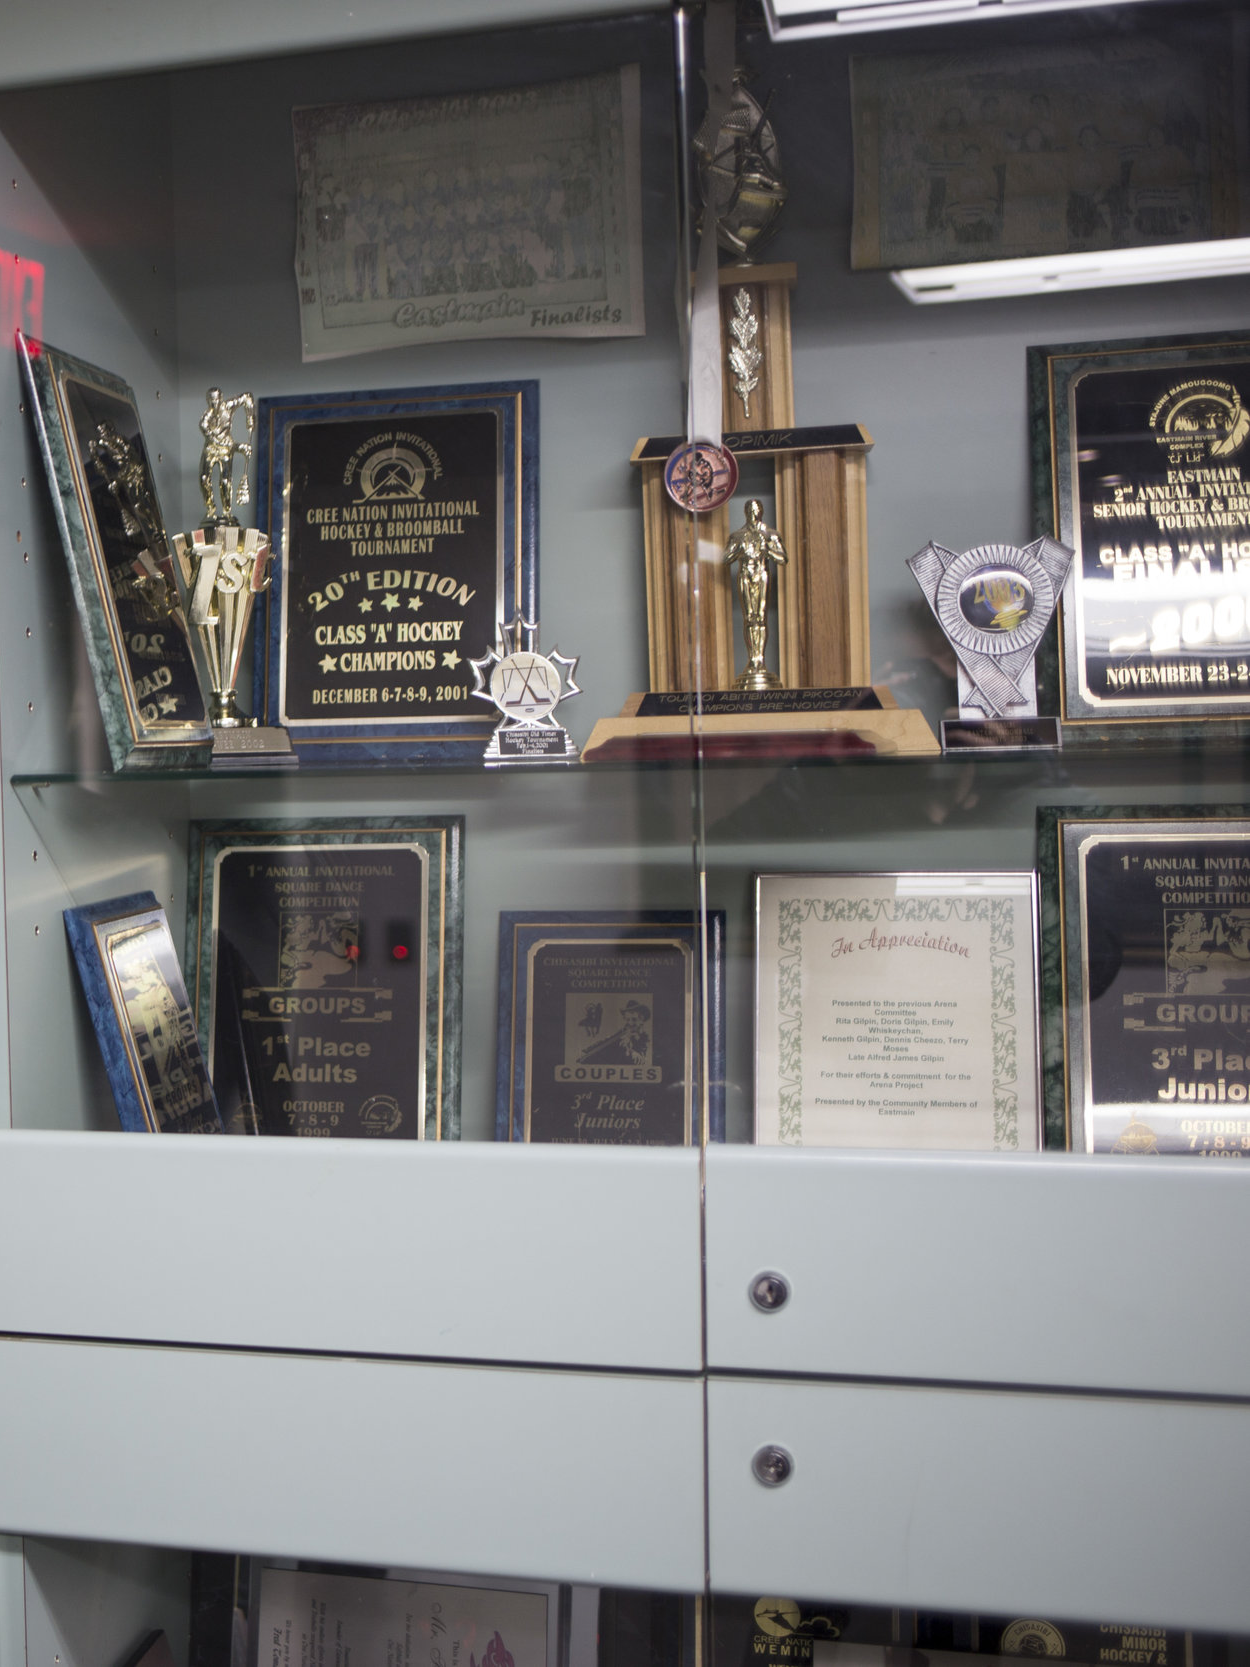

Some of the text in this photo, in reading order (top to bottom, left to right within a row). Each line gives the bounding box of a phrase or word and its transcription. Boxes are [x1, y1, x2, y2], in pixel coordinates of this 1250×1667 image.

[530, 304, 622, 327] Finalists
[724, 433, 793, 448] OPIMIK
[1156, 436, 1193, 444] EASTMAIN
[1170, 442, 1205, 451] COMPLEX
[343, 432, 443, 485] CREE NATION INVITATIONAL
[1168, 467, 1241, 484] EASTMAIN
[1114, 486, 1133, 502] 2nd
[1136, 485, 1191, 501] ANNUAL
[307, 500, 480, 524] CREE NATION INVITATIONAL
[1094, 497, 1250, 518] SENIOR HOCKEY & BR
[321, 518, 465, 541] HOCKEY & BROOMBALL
[351, 538, 435, 557] TOURNAMENT
[1100, 546, 1173, 564] CLASS
[1179, 544, 1215, 560] "A"
[308, 570, 477, 612] 20TH EDITION
[316, 620, 464, 645] CLASS "A" HOCKEY
[340, 650, 436, 672] CHAMPIONS
[1106, 666, 1203, 685] NOVEMBER
[313, 686, 468, 704] DECEMBER 6-7-8-9, 2001
[720, 690, 798, 701] ABITIBIWINNI
[802, 689, 863, 699] PIKOGAN
[679, 700, 840, 713] CHAMPIONS PRE-NOVICE
[1121, 856, 1139, 870] 1st
[1144, 858, 1200, 870] ANNUAL
[266, 866, 311, 877] ANNUAL
[315, 865, 396, 877] INVITATIONAL
[275, 881, 365, 894] SQUARE DANCE
[1155, 875, 1214, 889] SQUARE
[279, 896, 360, 908] COMPETITION
[831, 926, 971, 959] In Appreciation
[544, 957, 678, 967] CHISASIBI INVITATIONAL
[568, 968, 652, 978] SQUARE DANCE
[572, 979, 648, 989] COMPETITION
[269, 996, 367, 1015] GROUPS
[832, 1000, 871, 1008] Presented
[884, 1000, 896, 1008] the
[898, 1000, 932, 1010] previous
[934, 1000, 958, 1008] Arena
[854, 1018, 879, 1027] Gilpin,
[904, 1018, 930, 1027] Gilpin,
[932, 1018, 955, 1027] Emily
[868, 1027, 924, 1036] Whiskeychan,
[262, 1034, 372, 1057] 1st Place
[856, 1036, 882, 1045] Gilpin,
[884, 1036, 912, 1044] Dennis
[948, 1037, 969, 1046] Terry
[883, 1045, 909, 1053] Moses
[867, 1054, 891, 1062] Alfred
[893, 1054, 919, 1062] James
[920, 1055, 945, 1064] Gilpin
[1152, 1045, 1188, 1070] 3rd
[273, 1062, 358, 1084] Adults
[560, 1068, 658, 1081] COUPLES
[856, 1072, 881, 1080] efforts
[884, 1072, 890, 1080] &
[892, 1073, 941, 1081] commitment
[945, 1073, 957, 1081] for
[895, 1082, 924, 1091] Project
[283, 1100, 345, 1113] OCTOBER
[572, 1092, 645, 1111] 3rd Place
[815, 1098, 978, 1109] Presented by the Community Members of
[878, 1108, 916, 1116] Eastmain
[288, 1114, 340, 1126] 7 8 9
[574, 1112, 642, 1129] Juniors
[1188, 1135, 1198, 1148] 7
[1214, 1136, 1226, 1149] 8
[754, 1635, 781, 1645] CREE
[1122, 1636, 1167, 1652] MINOR
[754, 1642, 811, 1658] WEMIN
[1100, 1648, 1167, 1665] HOCKEY &
